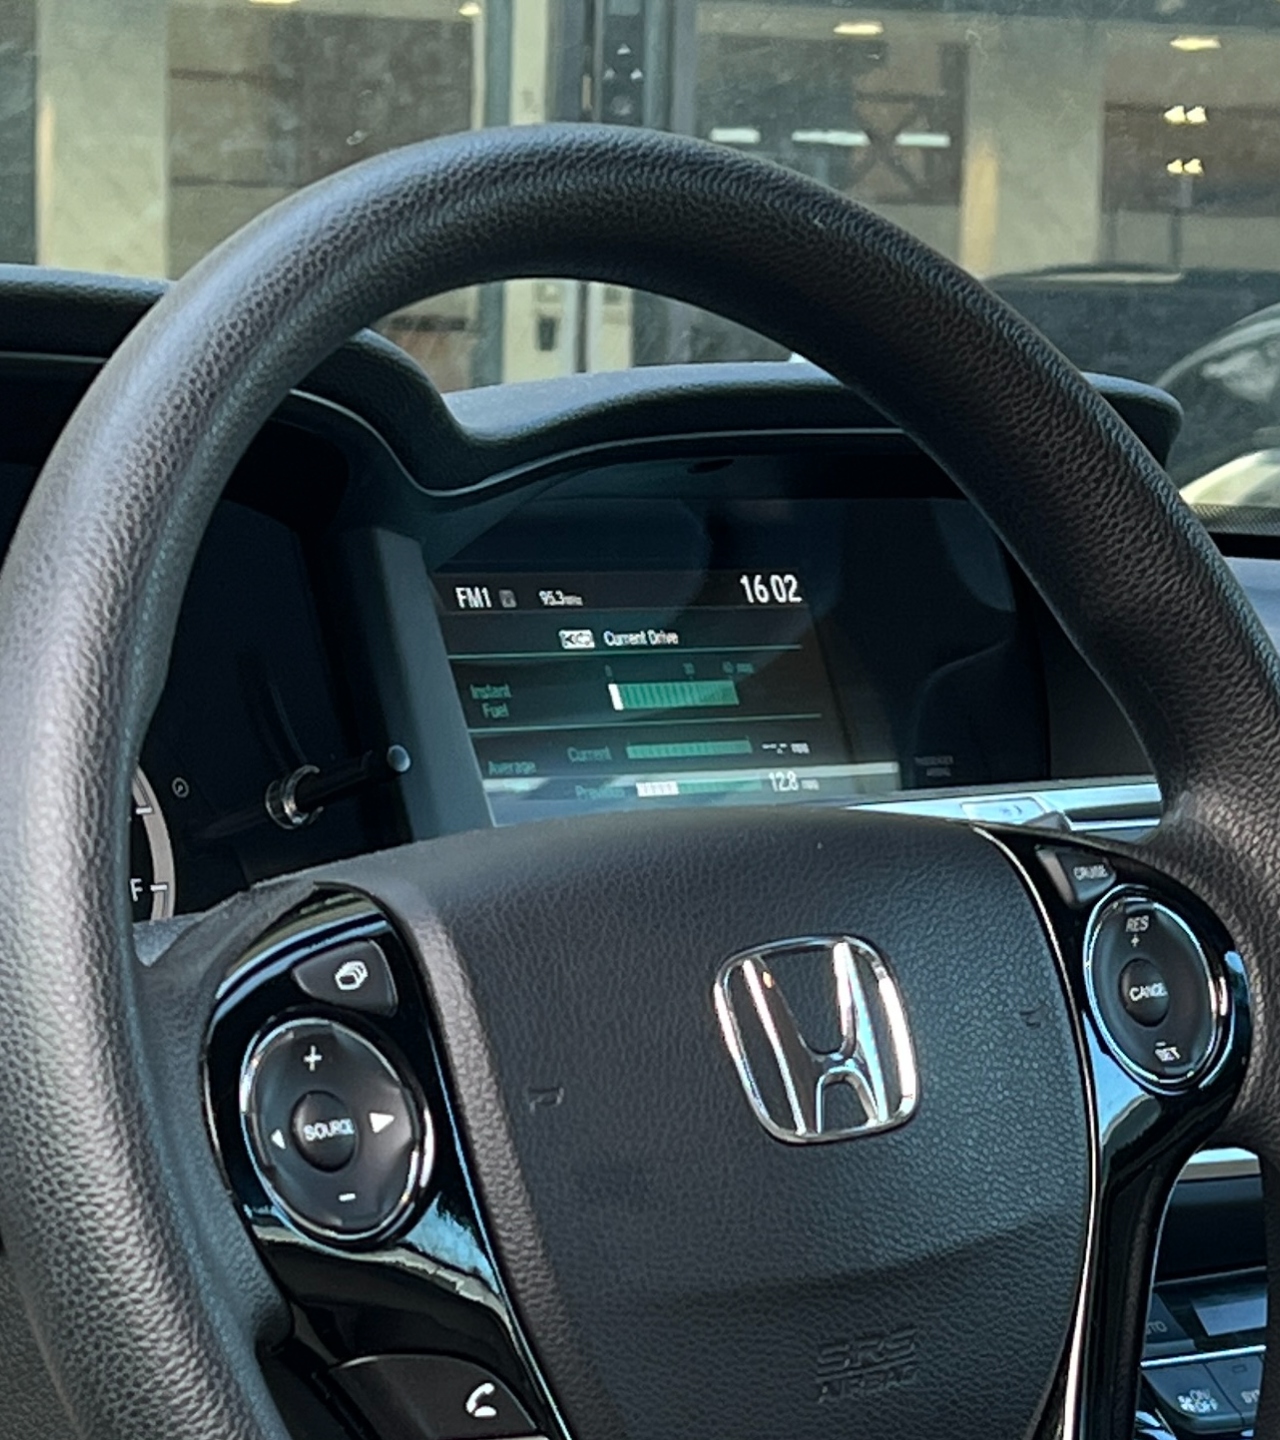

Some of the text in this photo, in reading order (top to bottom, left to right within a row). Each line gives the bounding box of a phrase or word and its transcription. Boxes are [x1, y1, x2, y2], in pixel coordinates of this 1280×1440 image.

[455, 586, 492, 609] FM1
[603, 629, 679, 647] Current Drive
[482, 702, 509, 718] Fuel
[130, 878, 142, 901] F
[1126, 915, 1150, 932] RES
[303, 1118, 355, 1141] SOURCE
